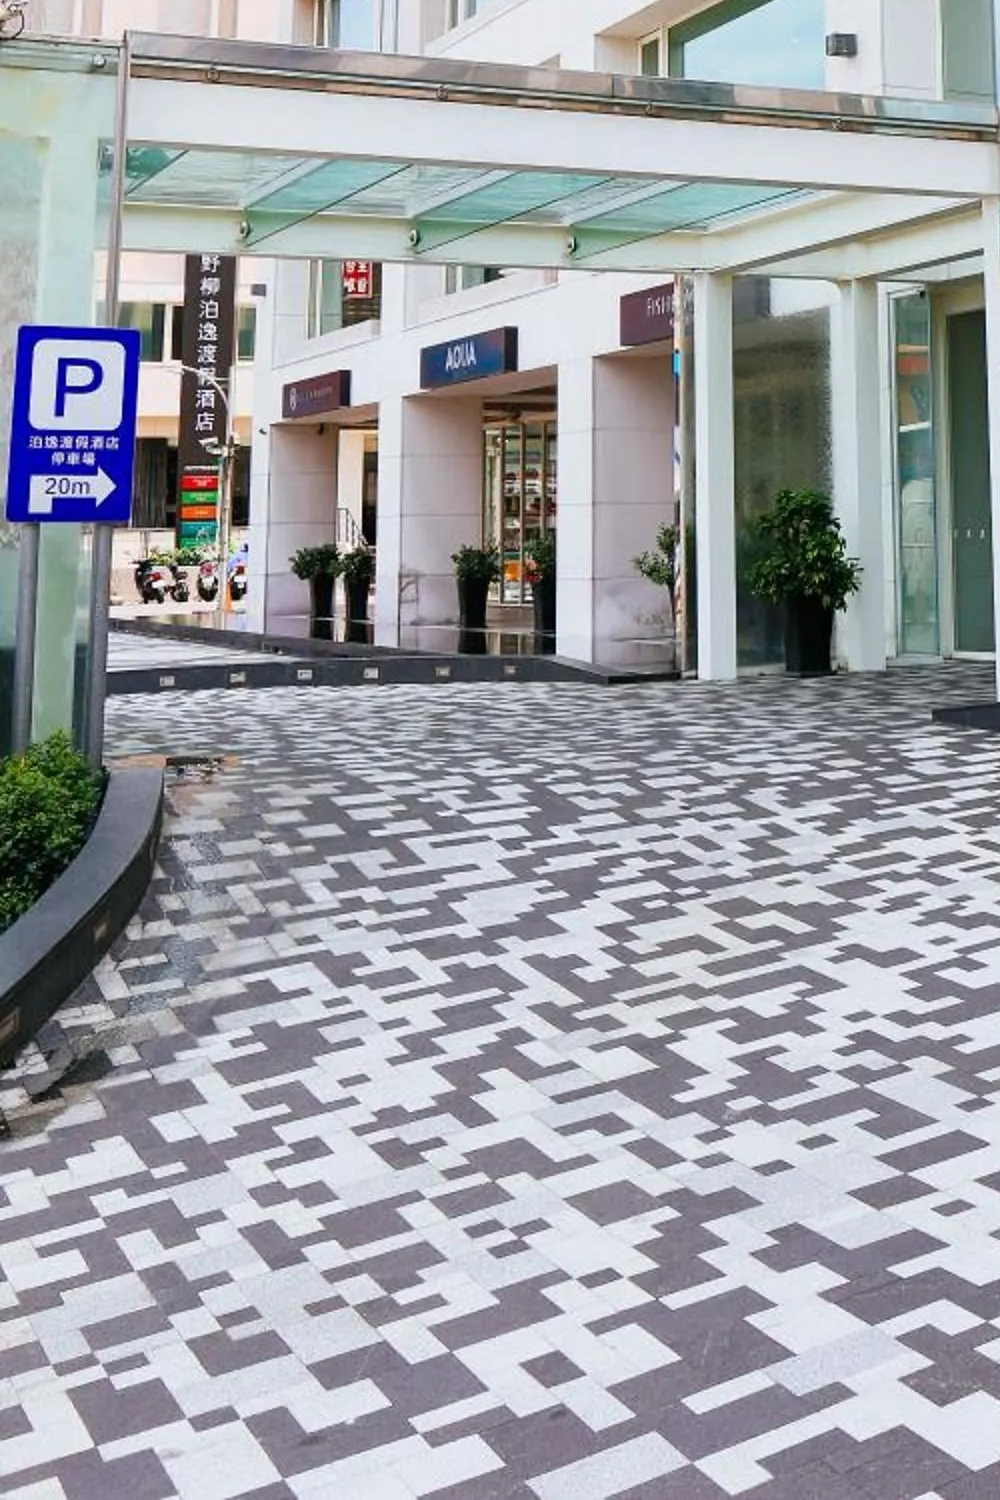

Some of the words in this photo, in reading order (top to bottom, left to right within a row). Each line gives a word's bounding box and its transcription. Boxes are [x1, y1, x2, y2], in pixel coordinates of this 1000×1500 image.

[54, 357, 104, 417] P
[51, 451, 95, 466] 停車場
[45, 477, 91, 495] 20m
